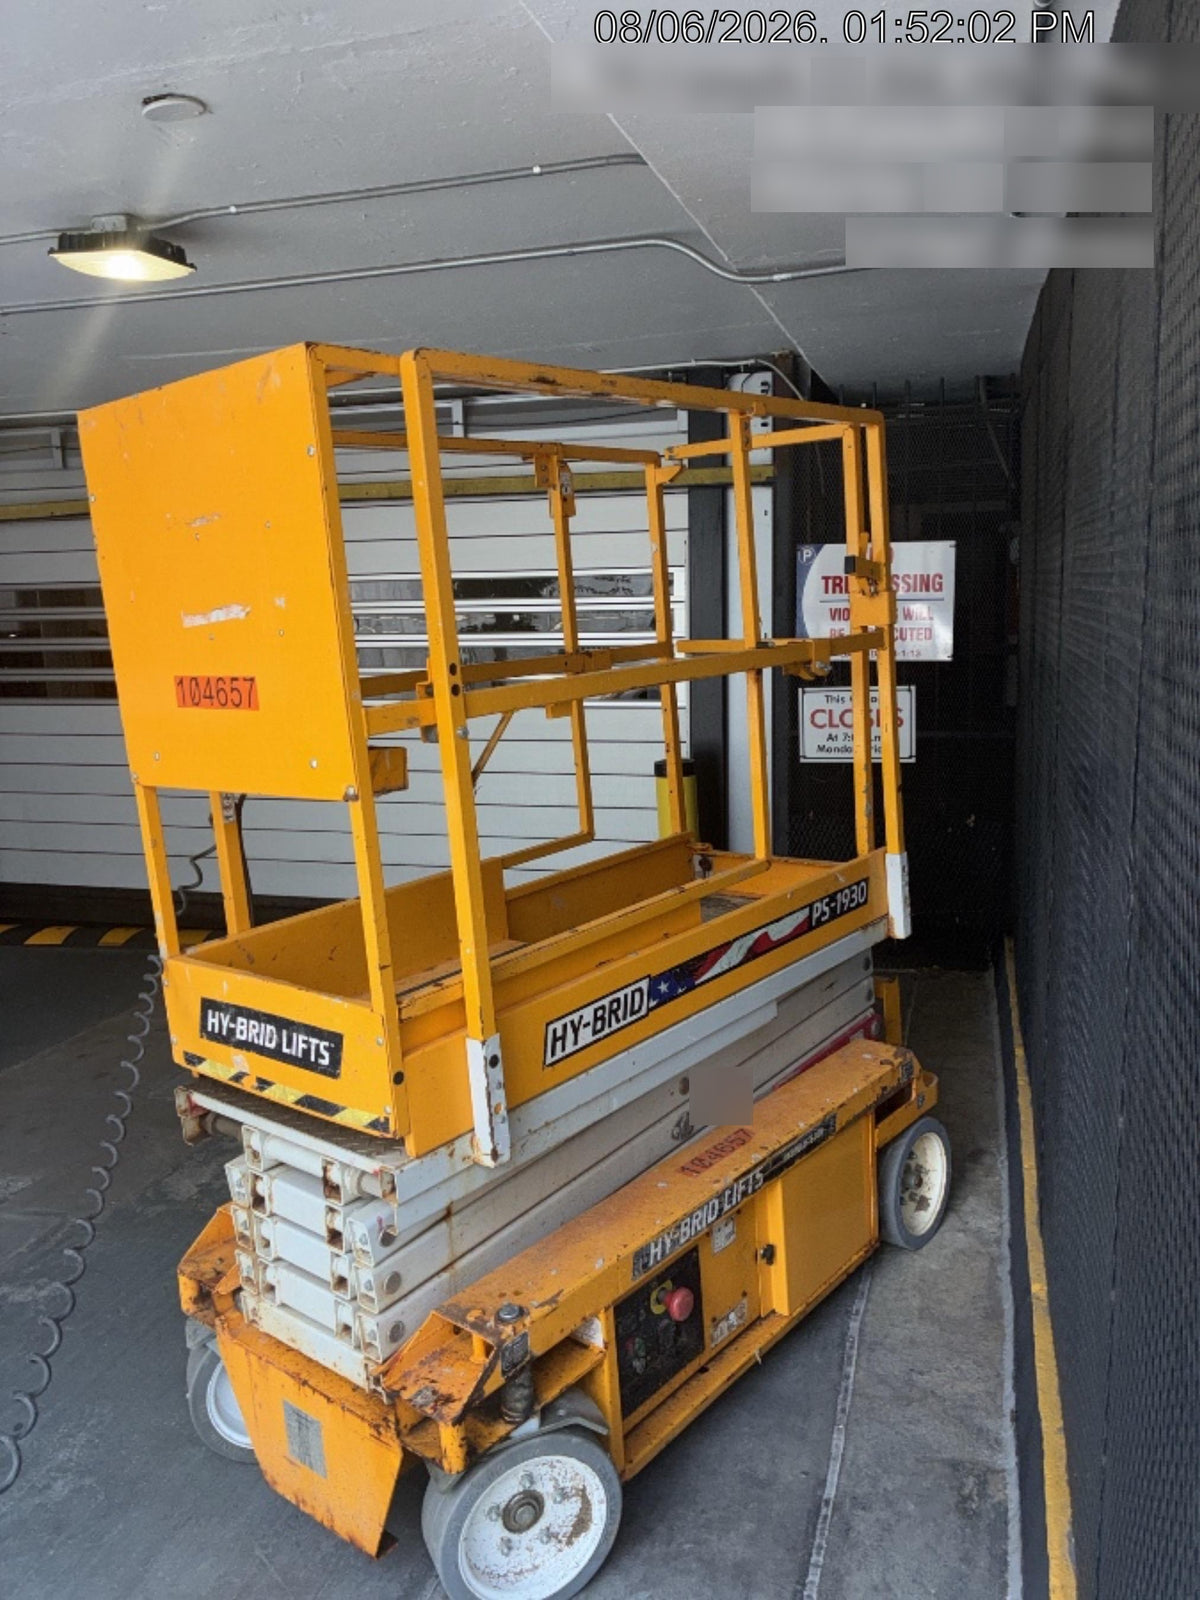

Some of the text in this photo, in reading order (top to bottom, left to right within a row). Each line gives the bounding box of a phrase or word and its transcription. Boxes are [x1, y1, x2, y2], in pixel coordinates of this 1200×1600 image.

[176, 676, 256, 708] 104657
[825, 694, 846, 704] This
[826, 733, 838, 742] At
[811, 882, 868, 926] PS-1930
[206, 1009, 278, 1050] HY-BRID
[549, 984, 647, 1058] HY-BRID
[649, 1196, 719, 1267] HY-BRID
[723, 1169, 765, 1212] LIFTS
